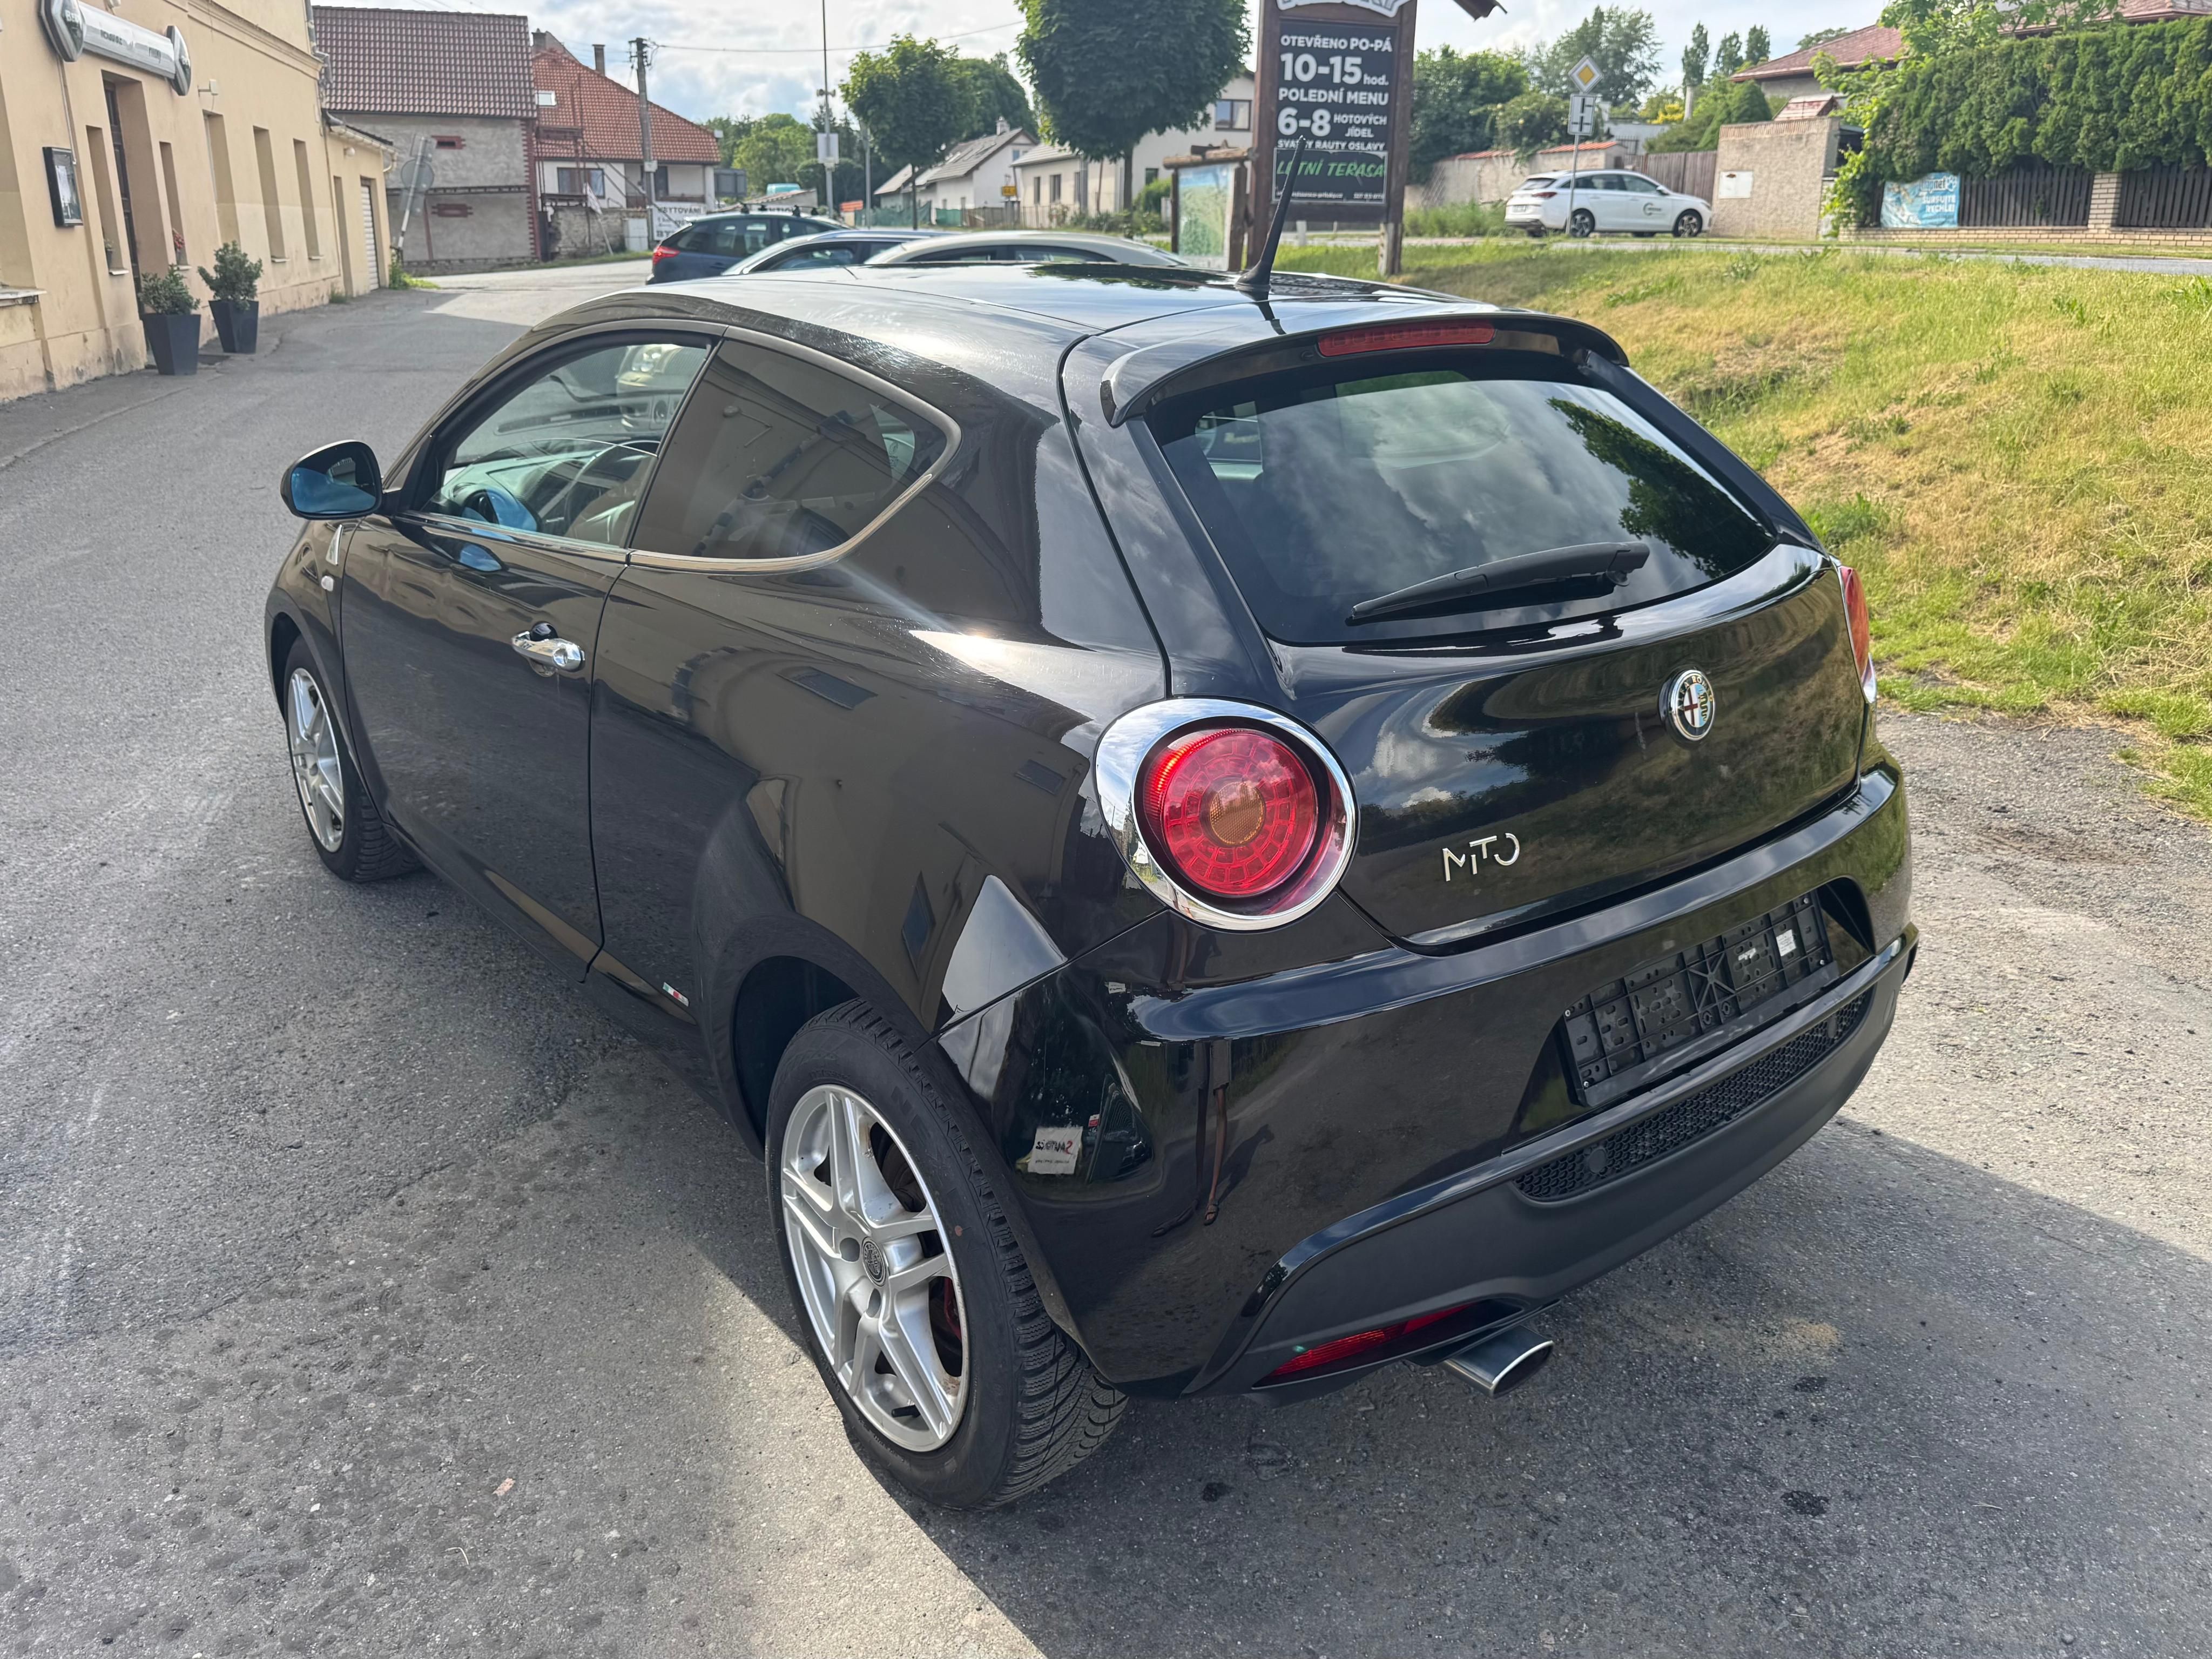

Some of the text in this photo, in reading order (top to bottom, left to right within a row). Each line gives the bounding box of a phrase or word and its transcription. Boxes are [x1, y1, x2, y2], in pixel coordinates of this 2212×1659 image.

[1280, 35, 1393, 52] OTEVŘENO PO-PÁ
[1280, 52, 1389, 85] 10-15 hod.
[1278, 87, 1389, 105] POLEDNÍ MENU
[1278, 107, 1331, 136] 6-8
[1333, 113, 1387, 125] HOTOVÝCH
[1345, 125, 1374, 137] JÍDEL
[1278, 139, 1385, 151] SVAY RAUTY OSLAVY
[1327, 161, 1384, 177] TERASA
